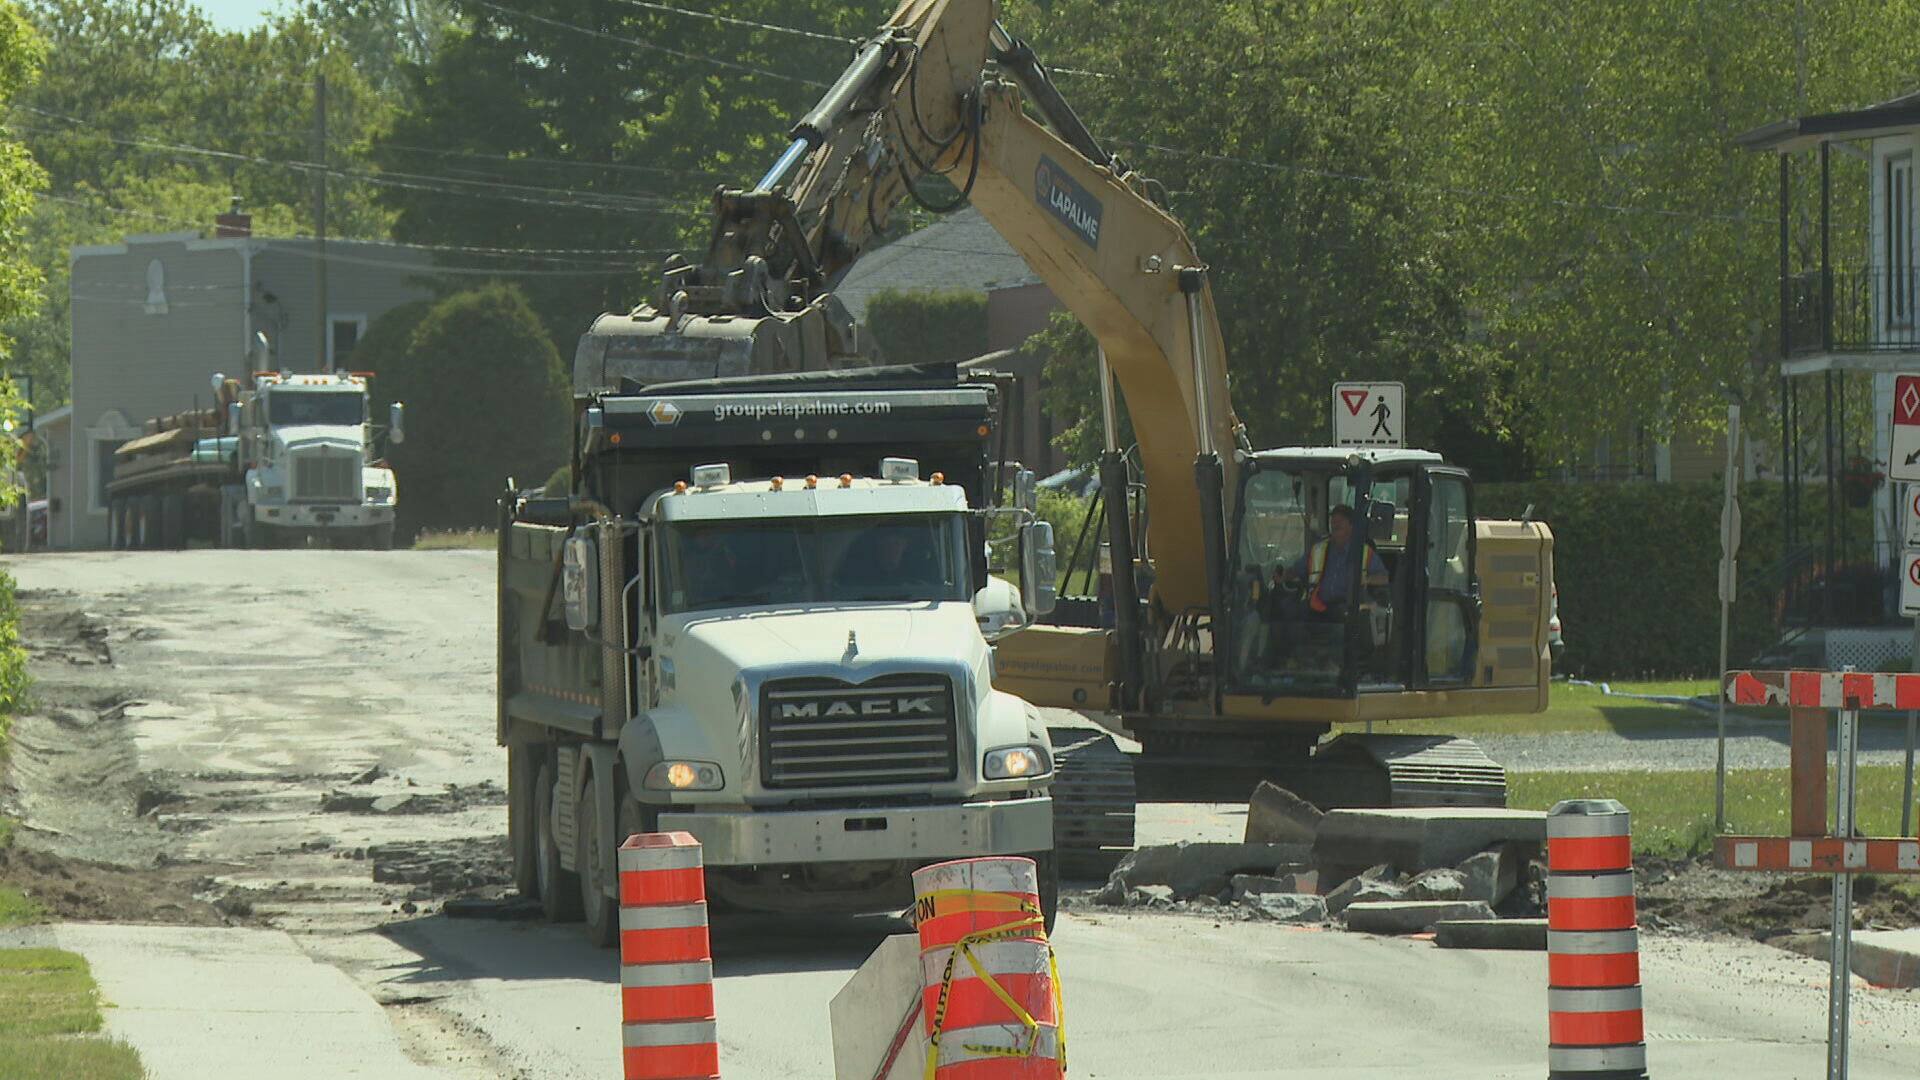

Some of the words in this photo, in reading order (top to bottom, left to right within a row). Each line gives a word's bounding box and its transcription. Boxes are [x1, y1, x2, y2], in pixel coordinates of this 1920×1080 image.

[1050, 185, 1098, 239] LAPALME
[713, 399, 892, 421] groupelapalme.com
[781, 697, 937, 718] MACK
